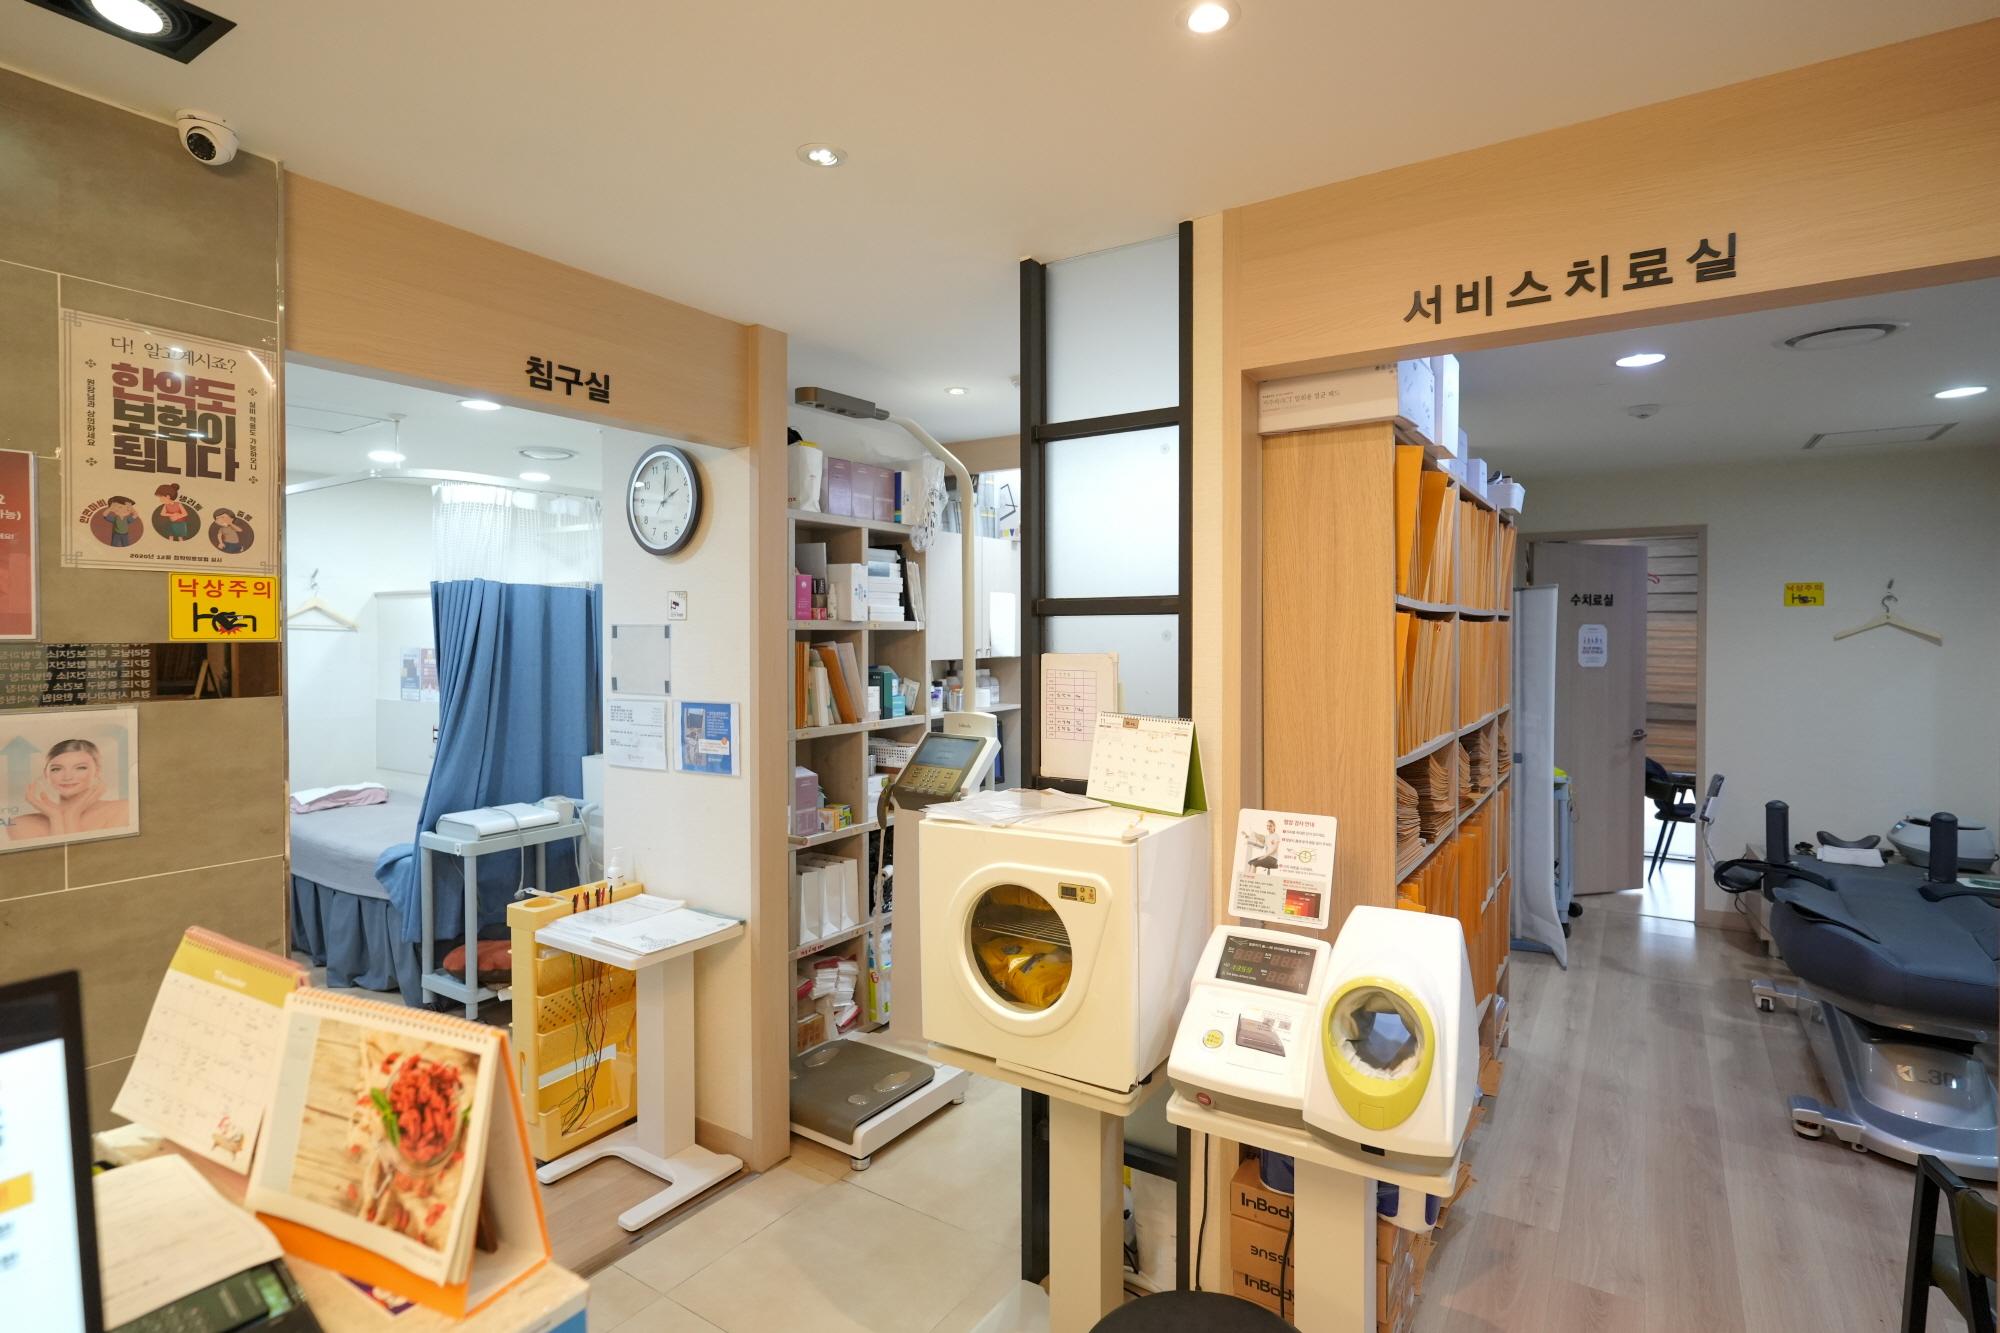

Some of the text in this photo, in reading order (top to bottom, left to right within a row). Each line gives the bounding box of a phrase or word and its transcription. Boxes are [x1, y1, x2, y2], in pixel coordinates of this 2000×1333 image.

[1403, 232, 1737, 325] 서비스치료실
[110, 336, 135, 355] 다!
[110, 362, 237, 416] 한약도
[525, 356, 610, 404] 침구실
[87, 410, 96, 447] 상의하세요
[111, 398, 237, 450] 보험이
[112, 434, 240, 482] 됩니다
[662, 461, 670, 470] 12
[652, 466, 658, 475] 11
[644, 481, 651, 490] 10
[79, 498, 108, 524] 안면마비
[644, 516, 649, 524] 8
[652, 527, 657, 536] 7
[663, 531, 668, 540] 6
[674, 527, 680, 535] 5
[176, 577, 273, 599] 낙상주의
[1570, 593, 1614, 607] 수치료실
